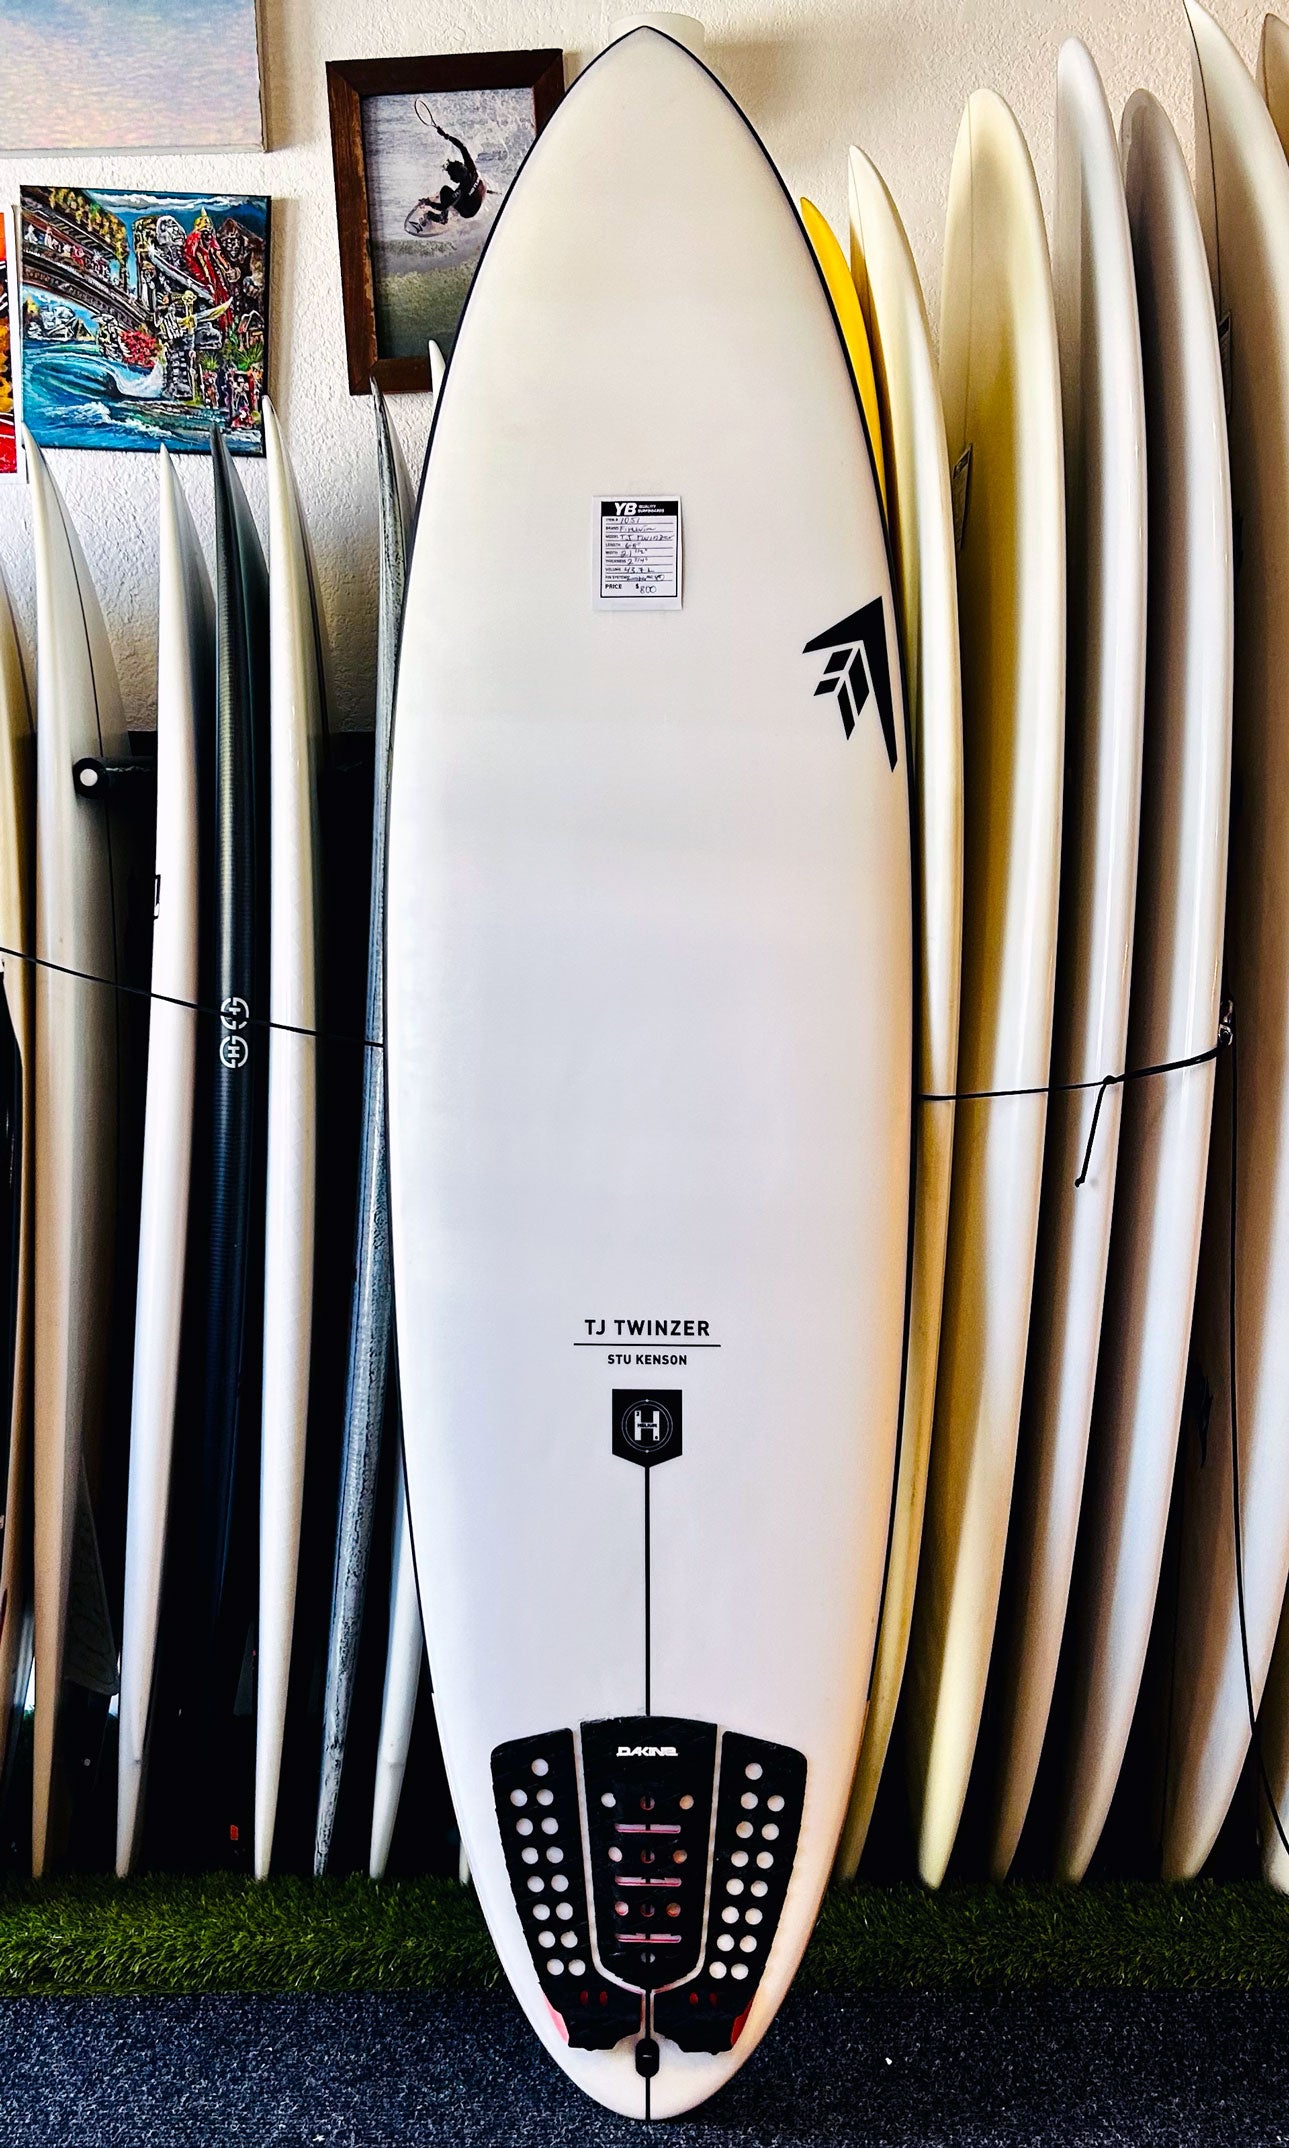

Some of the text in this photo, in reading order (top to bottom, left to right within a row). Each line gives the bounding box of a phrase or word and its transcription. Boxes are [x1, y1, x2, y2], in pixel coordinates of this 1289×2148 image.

[614, 502, 638, 516] YB
[585, 1319, 710, 1336] TJ TWINZER
[607, 1354, 688, 1366] STU KENSON
[616, 1746, 679, 1757] DAKINE
